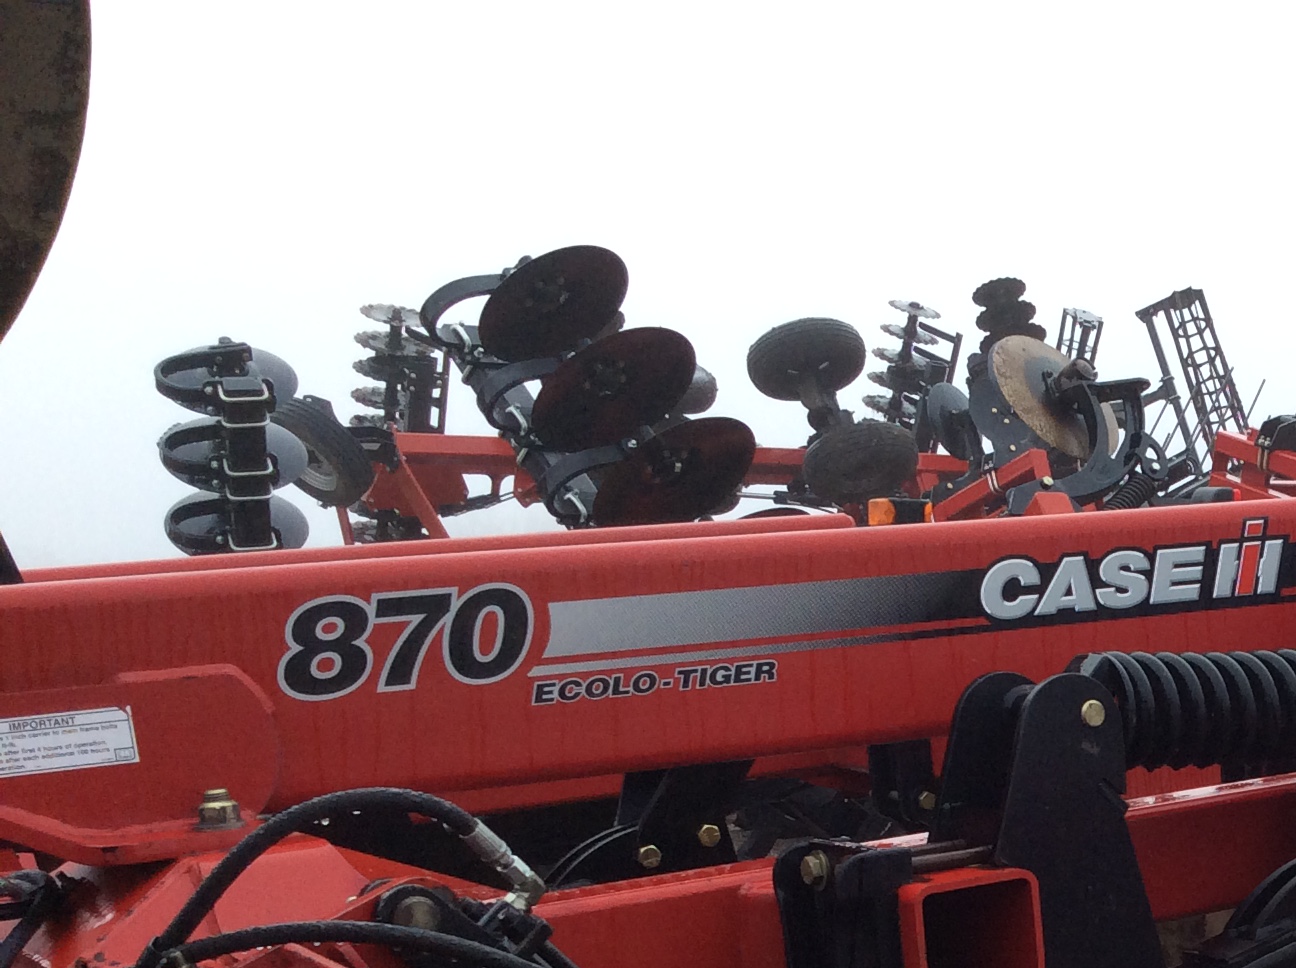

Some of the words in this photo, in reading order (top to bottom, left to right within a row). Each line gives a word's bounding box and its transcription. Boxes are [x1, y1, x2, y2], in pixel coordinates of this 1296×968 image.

[980, 545, 1206, 620] CASE
[277, 582, 534, 700] 870
[531, 660, 778, 705] ECOLO-TIGER
[9, 716, 75, 731] IMPORTANT
